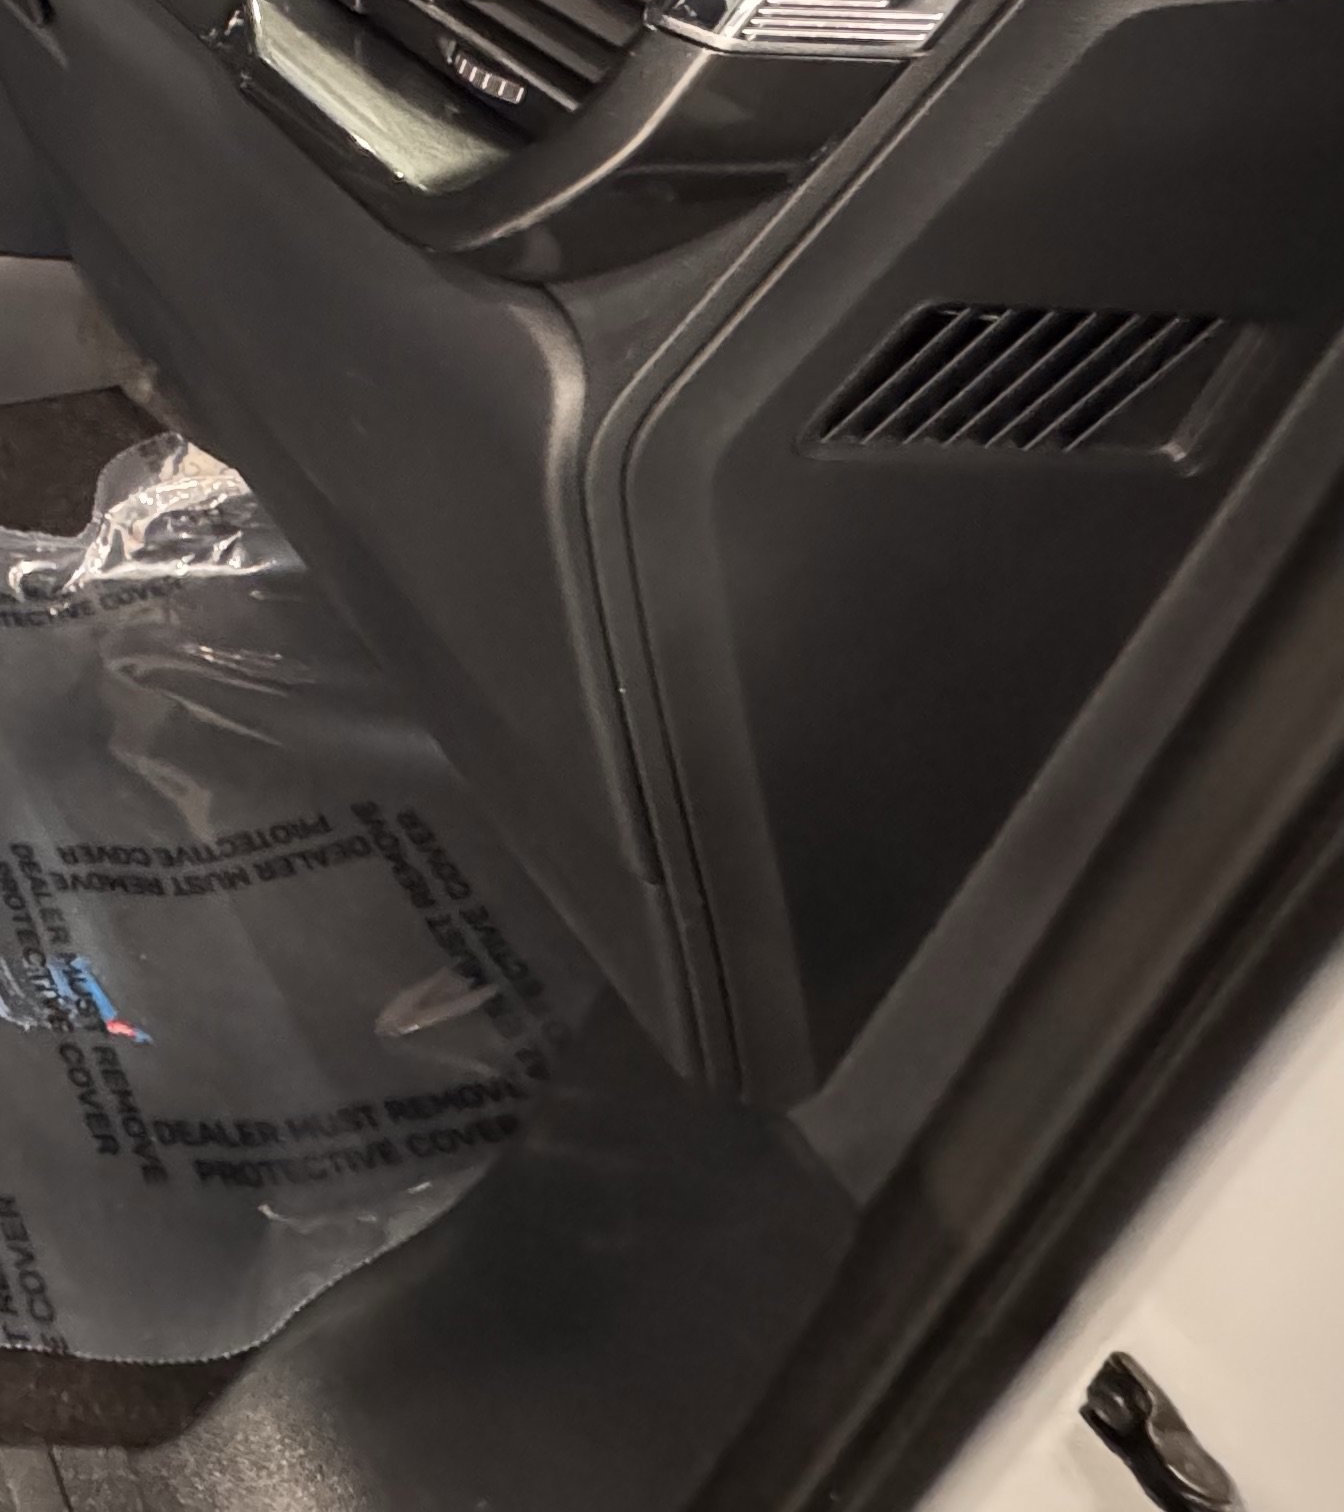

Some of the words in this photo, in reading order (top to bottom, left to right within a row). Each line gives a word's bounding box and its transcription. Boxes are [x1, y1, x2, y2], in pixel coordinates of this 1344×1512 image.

[56, 843, 152, 868] COVER
[151, 813, 332, 869] PROTECTIVE
[253, 835, 372, 883] DEALER
[47, 871, 166, 897] REMOVE
[170, 865, 252, 897] MUST
[9, 842, 73, 946] DEALER
[58, 951, 110, 1033] MUST
[91, 1044, 170, 1184] REMOVE
[58, 1040, 122, 1157] COVER
[152, 1118, 283, 1149] DEALER
[284, 1103, 380, 1138] MUST
[192, 1137, 404, 1188] PROTECTIVE
[405, 1110, 521, 1159] COVER
